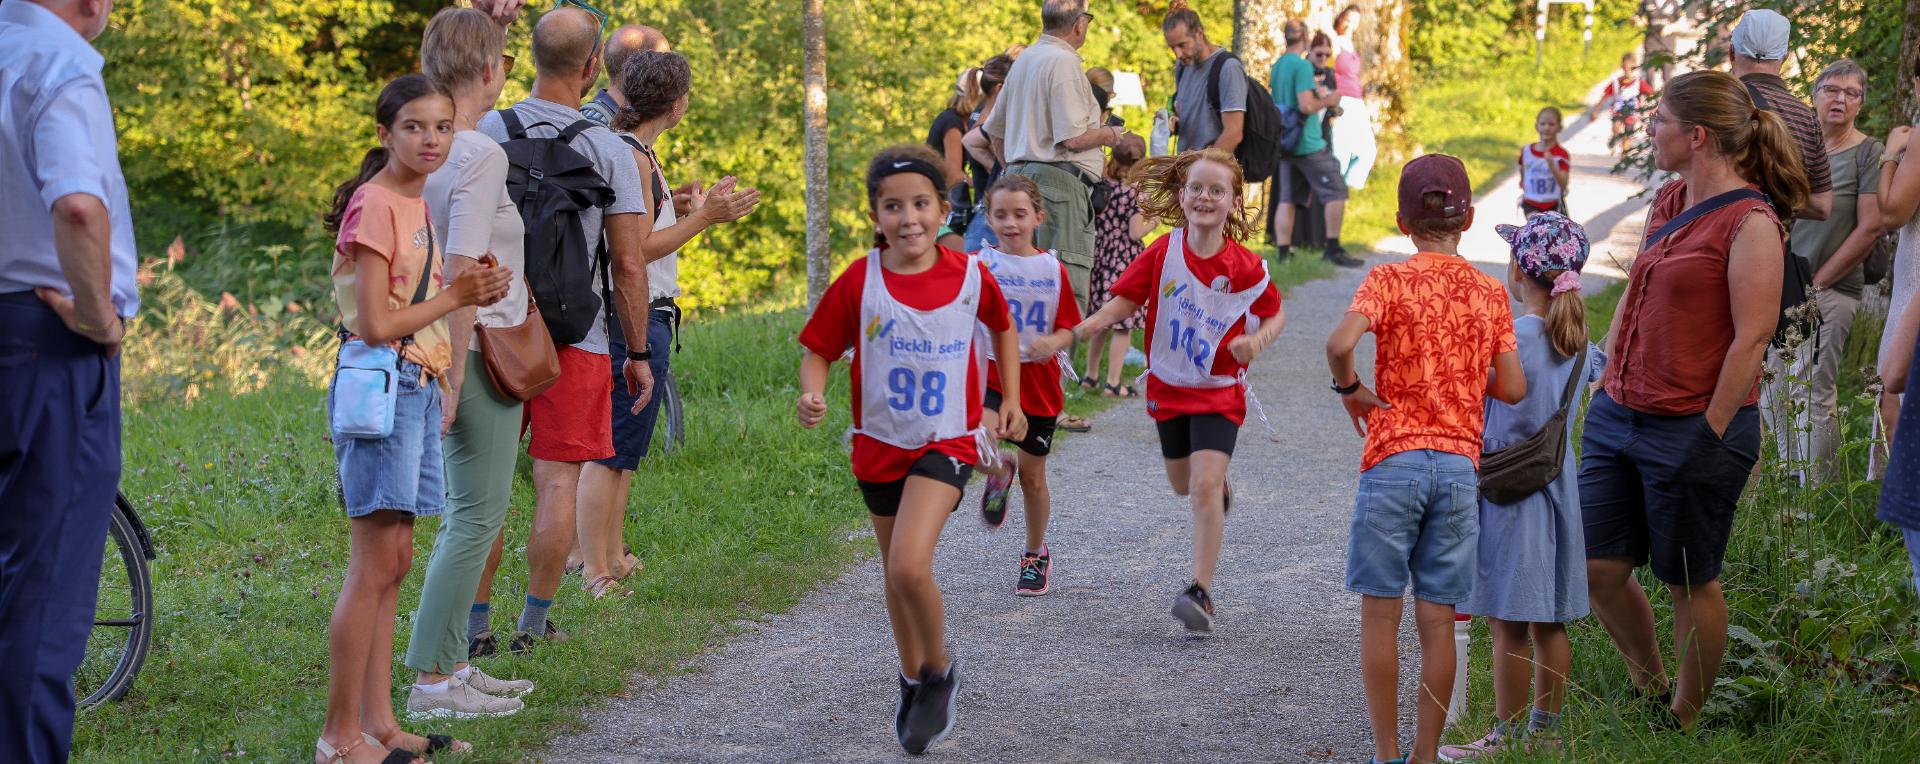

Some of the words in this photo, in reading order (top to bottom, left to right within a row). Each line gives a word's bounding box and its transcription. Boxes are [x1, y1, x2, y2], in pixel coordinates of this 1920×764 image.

[1530, 177, 1556, 195] 187
[889, 335, 932, 357] jäckli
[887, 366, 947, 417] 98
